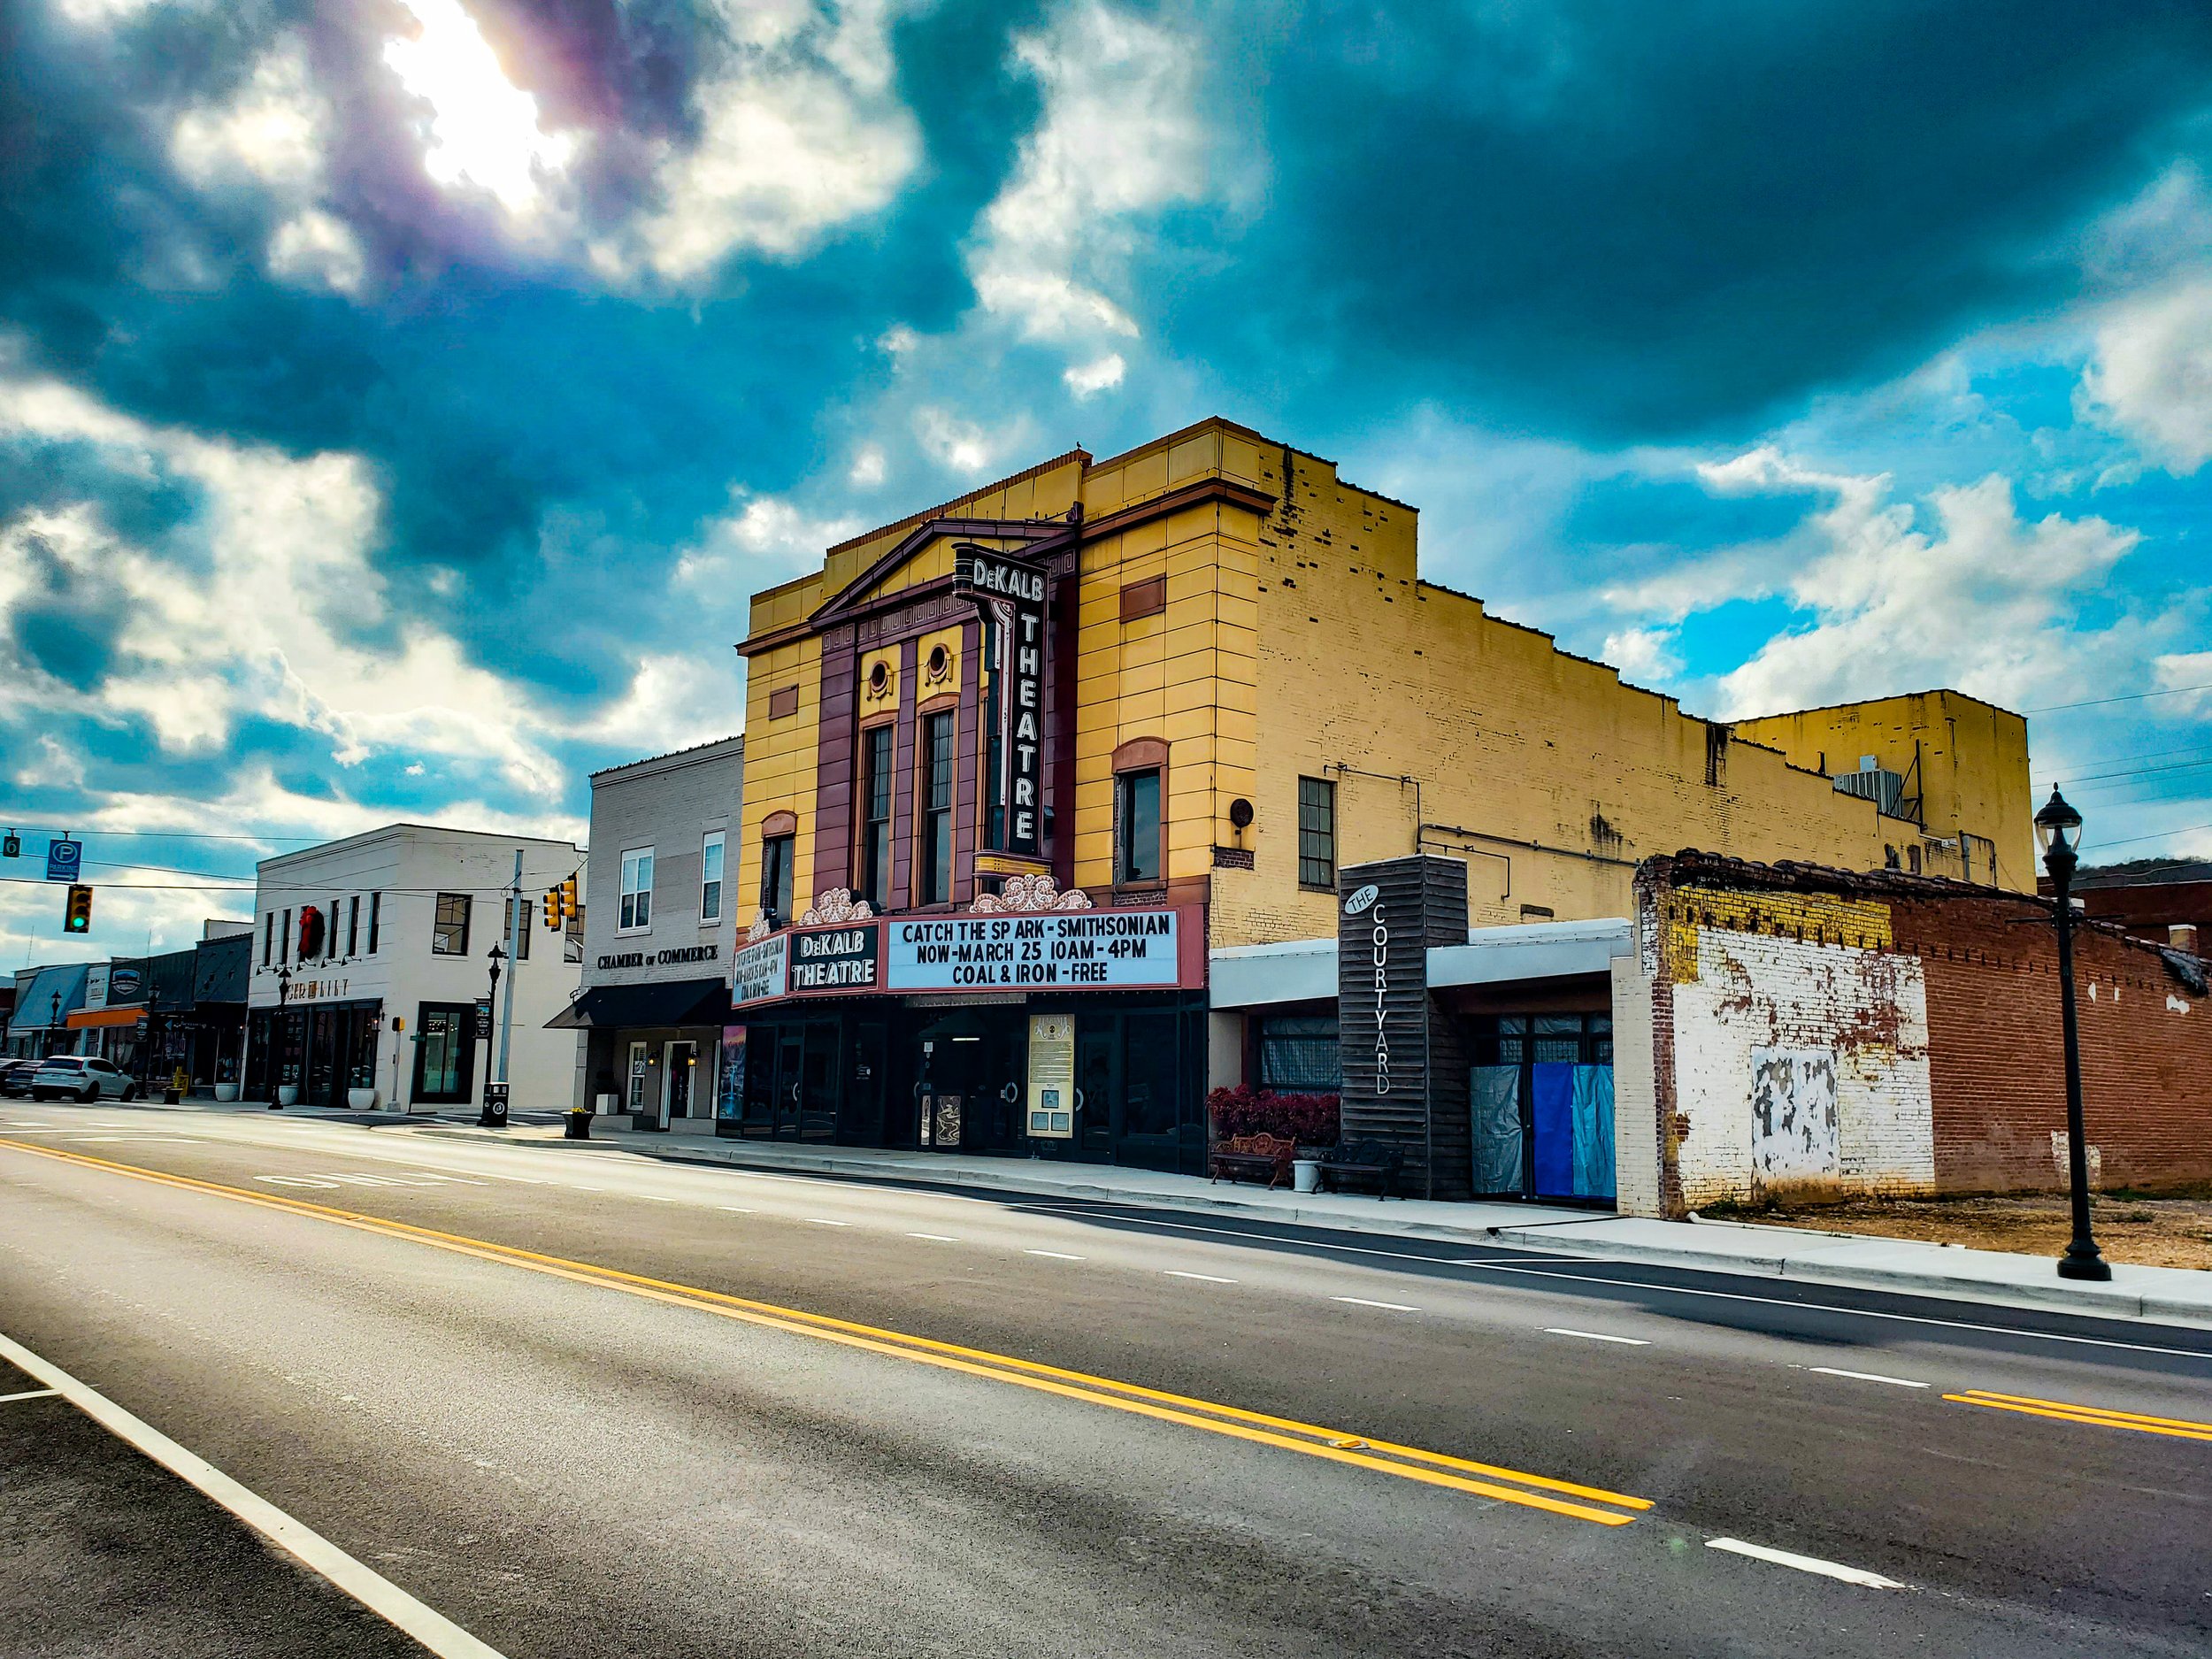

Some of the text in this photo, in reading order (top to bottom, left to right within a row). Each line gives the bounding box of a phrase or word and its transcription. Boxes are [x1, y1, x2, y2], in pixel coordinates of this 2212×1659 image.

[1016, 613, 1039, 840] THEATRE
[6, 840, 17, 854] 6
[59, 845, 73, 860] P
[49, 864, 79, 872] PARKING
[1348, 887, 1373, 911] THE
[902, 923, 954, 943] CATCH
[957, 921, 987, 941] THE
[597, 952, 643, 969] CHAMBER
[657, 945, 718, 964] COMMERCE
[1020, 941, 1042, 961] 25
[792, 958, 874, 991] THEATRE
[952, 964, 996, 985] COAL
[1000, 964, 1011, 983] &
[1016, 963, 1057, 983] IRON
[319, 979, 349, 997] LILY
[1373, 904, 1390, 1094] COURTYARD
[252, 1172, 488, 1188] ONLY
